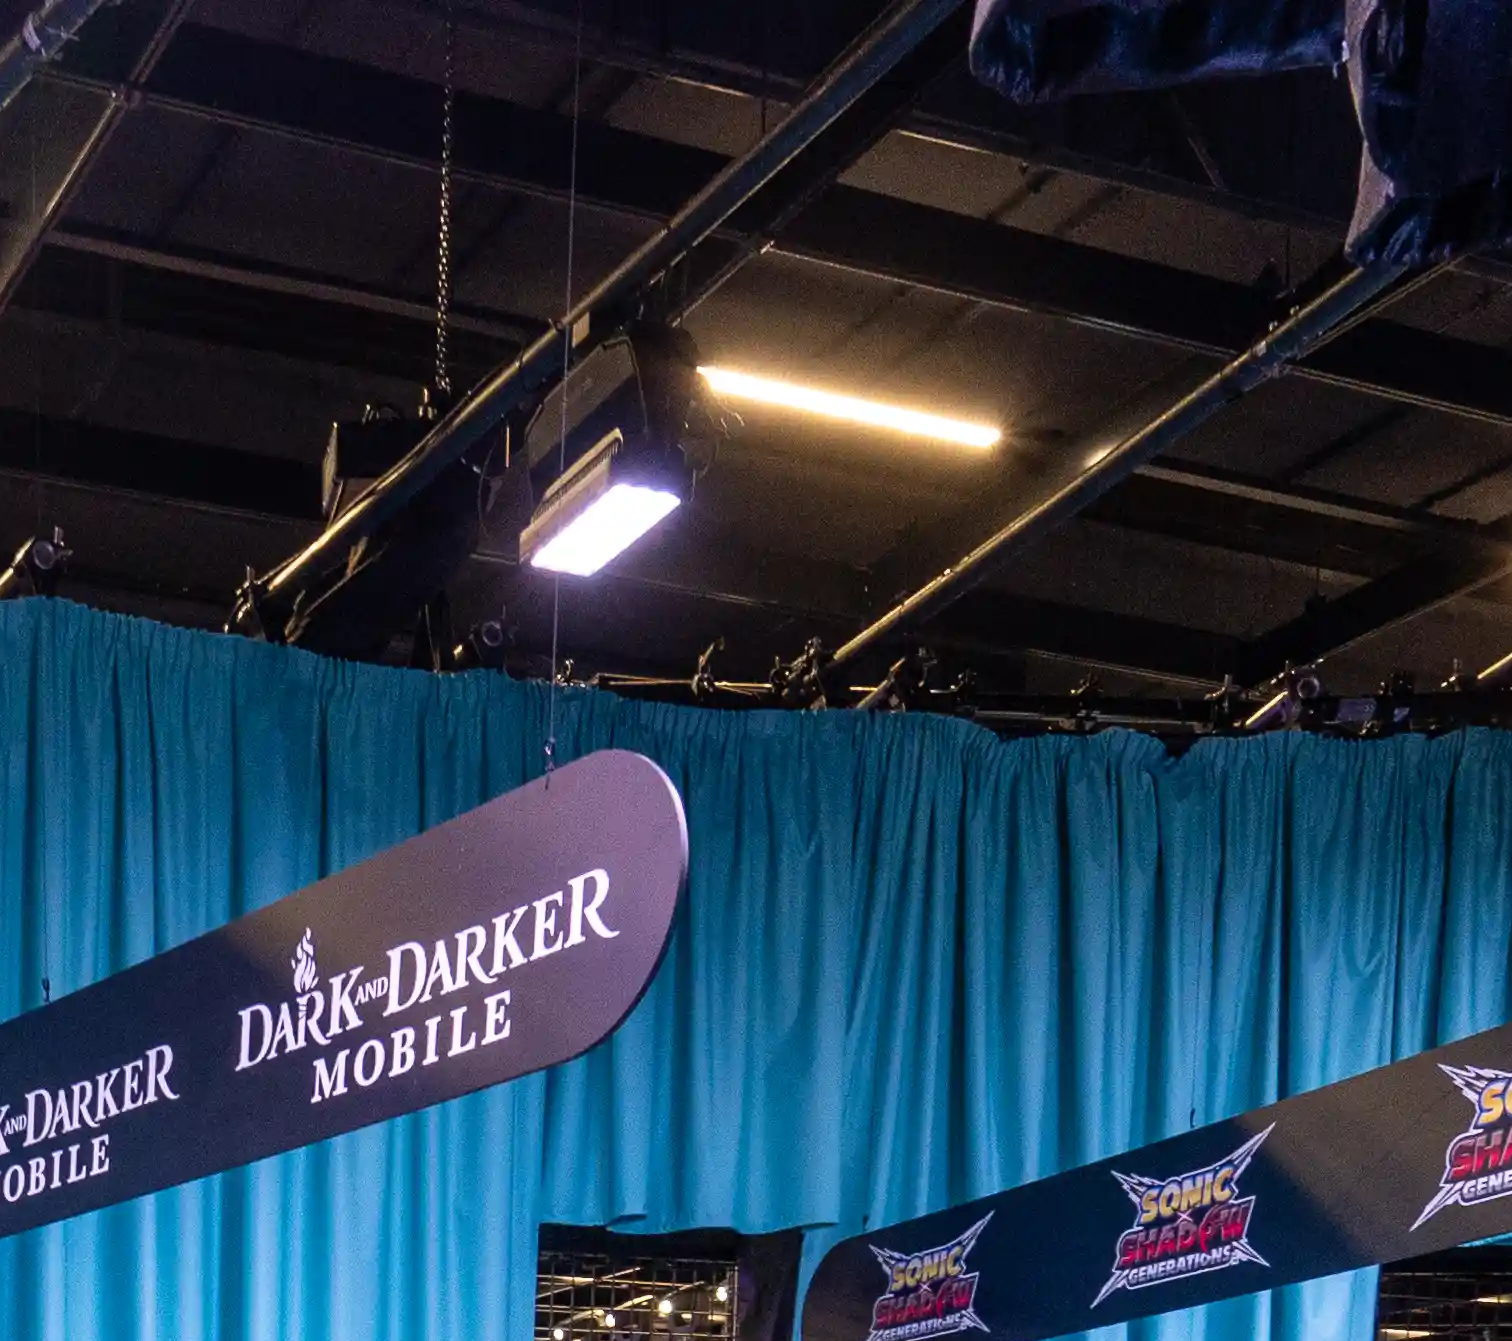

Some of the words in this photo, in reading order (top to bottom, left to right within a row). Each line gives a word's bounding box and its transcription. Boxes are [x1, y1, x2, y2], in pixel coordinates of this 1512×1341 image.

[234, 966, 364, 1072] DARK
[354, 975, 389, 1007] AND
[382, 868, 620, 1018] DARKER
[311, 990, 511, 1104] MOBILE
[3, 1114, 27, 1136] AND
[23, 1044, 180, 1147] DARKER
[1140, 1166, 1234, 1224] SONIC
[1119, 1203, 1250, 1267] SHADOW
[1127, 1244, 1233, 1284] GENERATIONS
[890, 1245, 964, 1292] SONIC
